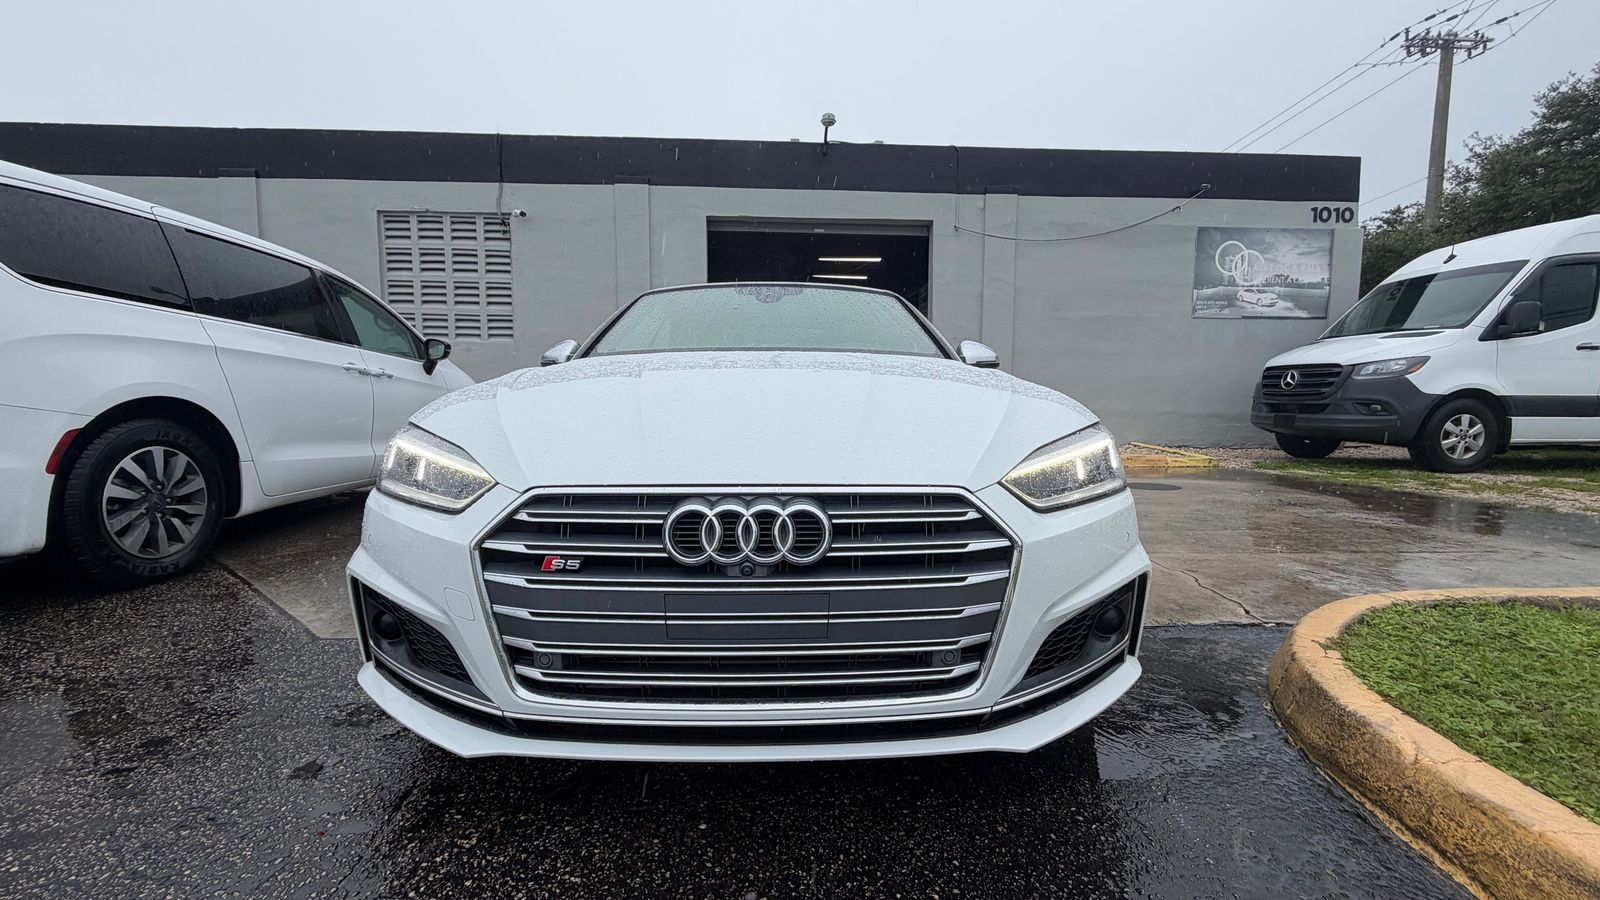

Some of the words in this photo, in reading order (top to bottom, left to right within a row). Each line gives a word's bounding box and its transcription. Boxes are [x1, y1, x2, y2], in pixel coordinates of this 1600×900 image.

[1310, 206, 1355, 224] 1010
[1267, 276, 1285, 284] RENT
[550, 559, 581, 570] S5
